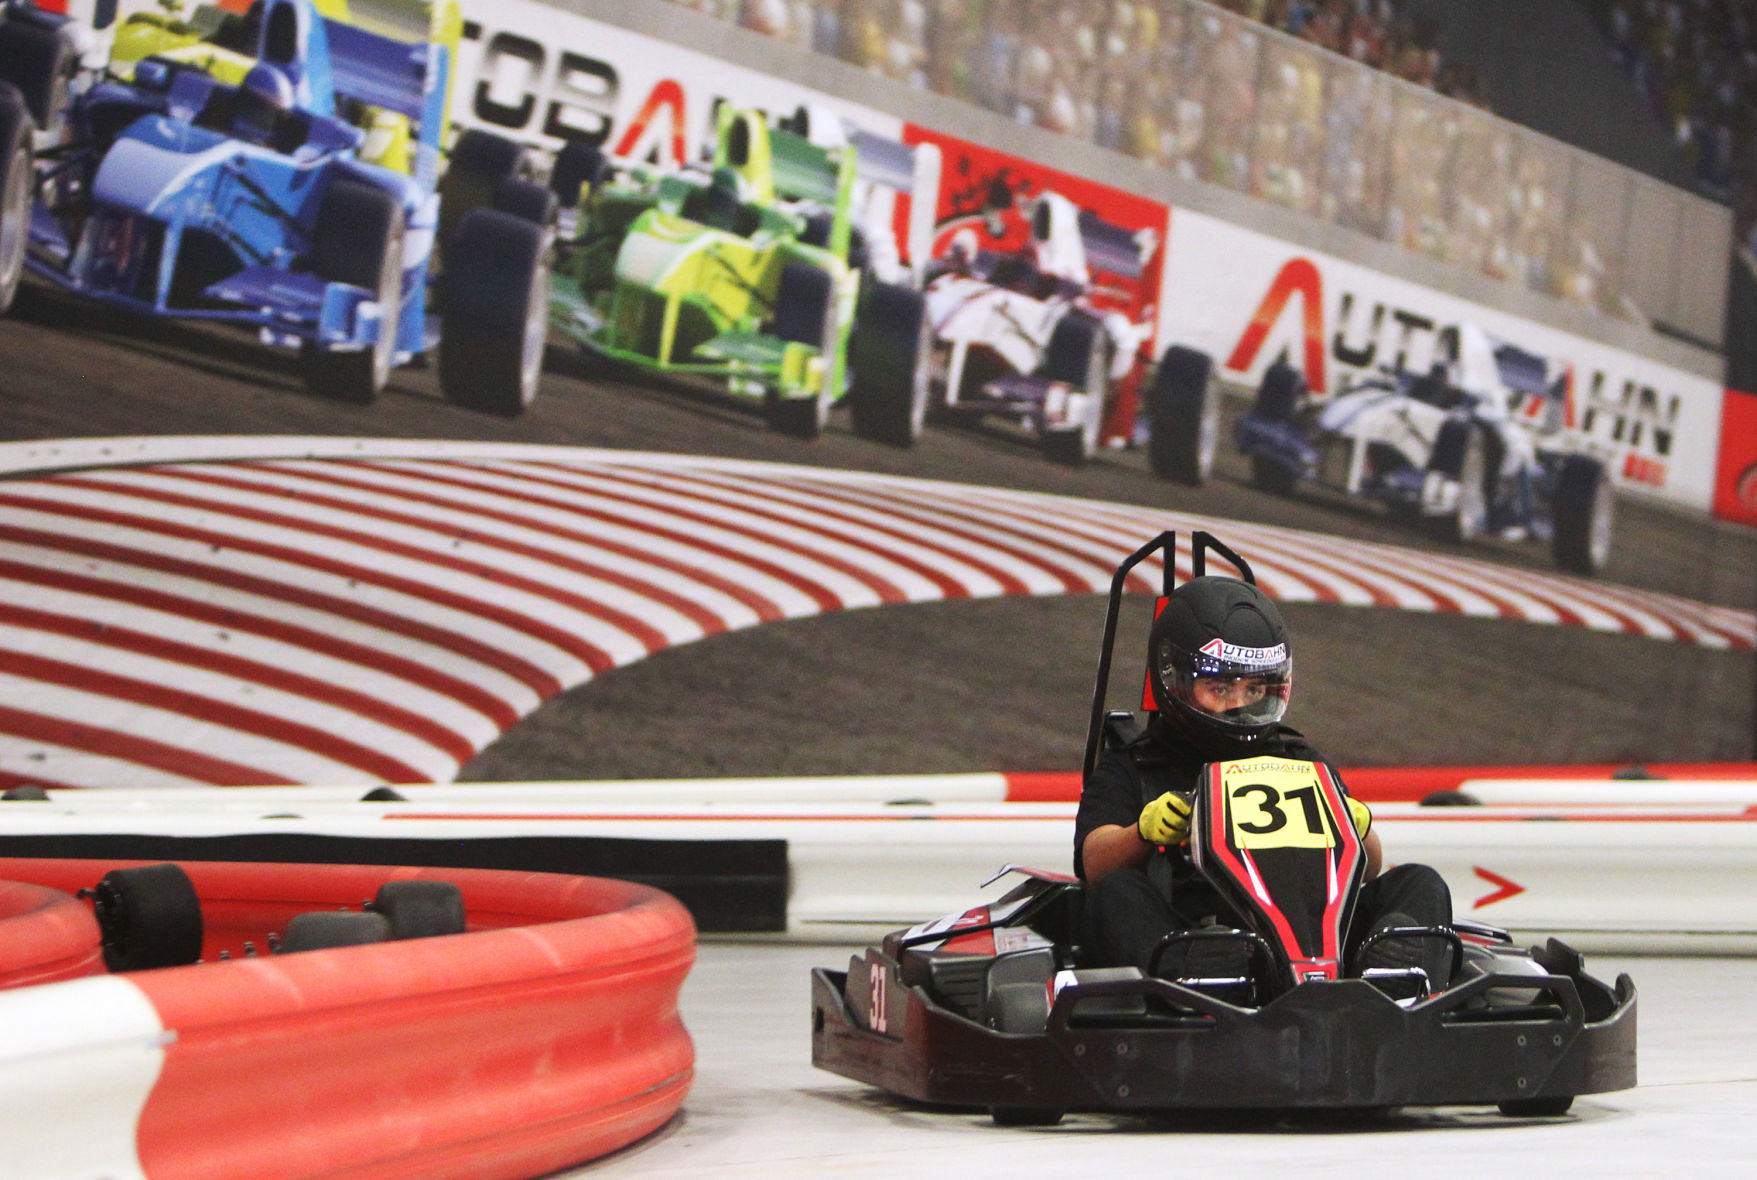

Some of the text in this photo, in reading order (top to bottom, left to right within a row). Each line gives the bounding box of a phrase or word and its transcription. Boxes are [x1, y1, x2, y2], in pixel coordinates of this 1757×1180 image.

[1202, 640, 1286, 659] AUTOBAHN
[1232, 783, 1325, 835] 31
[869, 963, 887, 1033] 31
